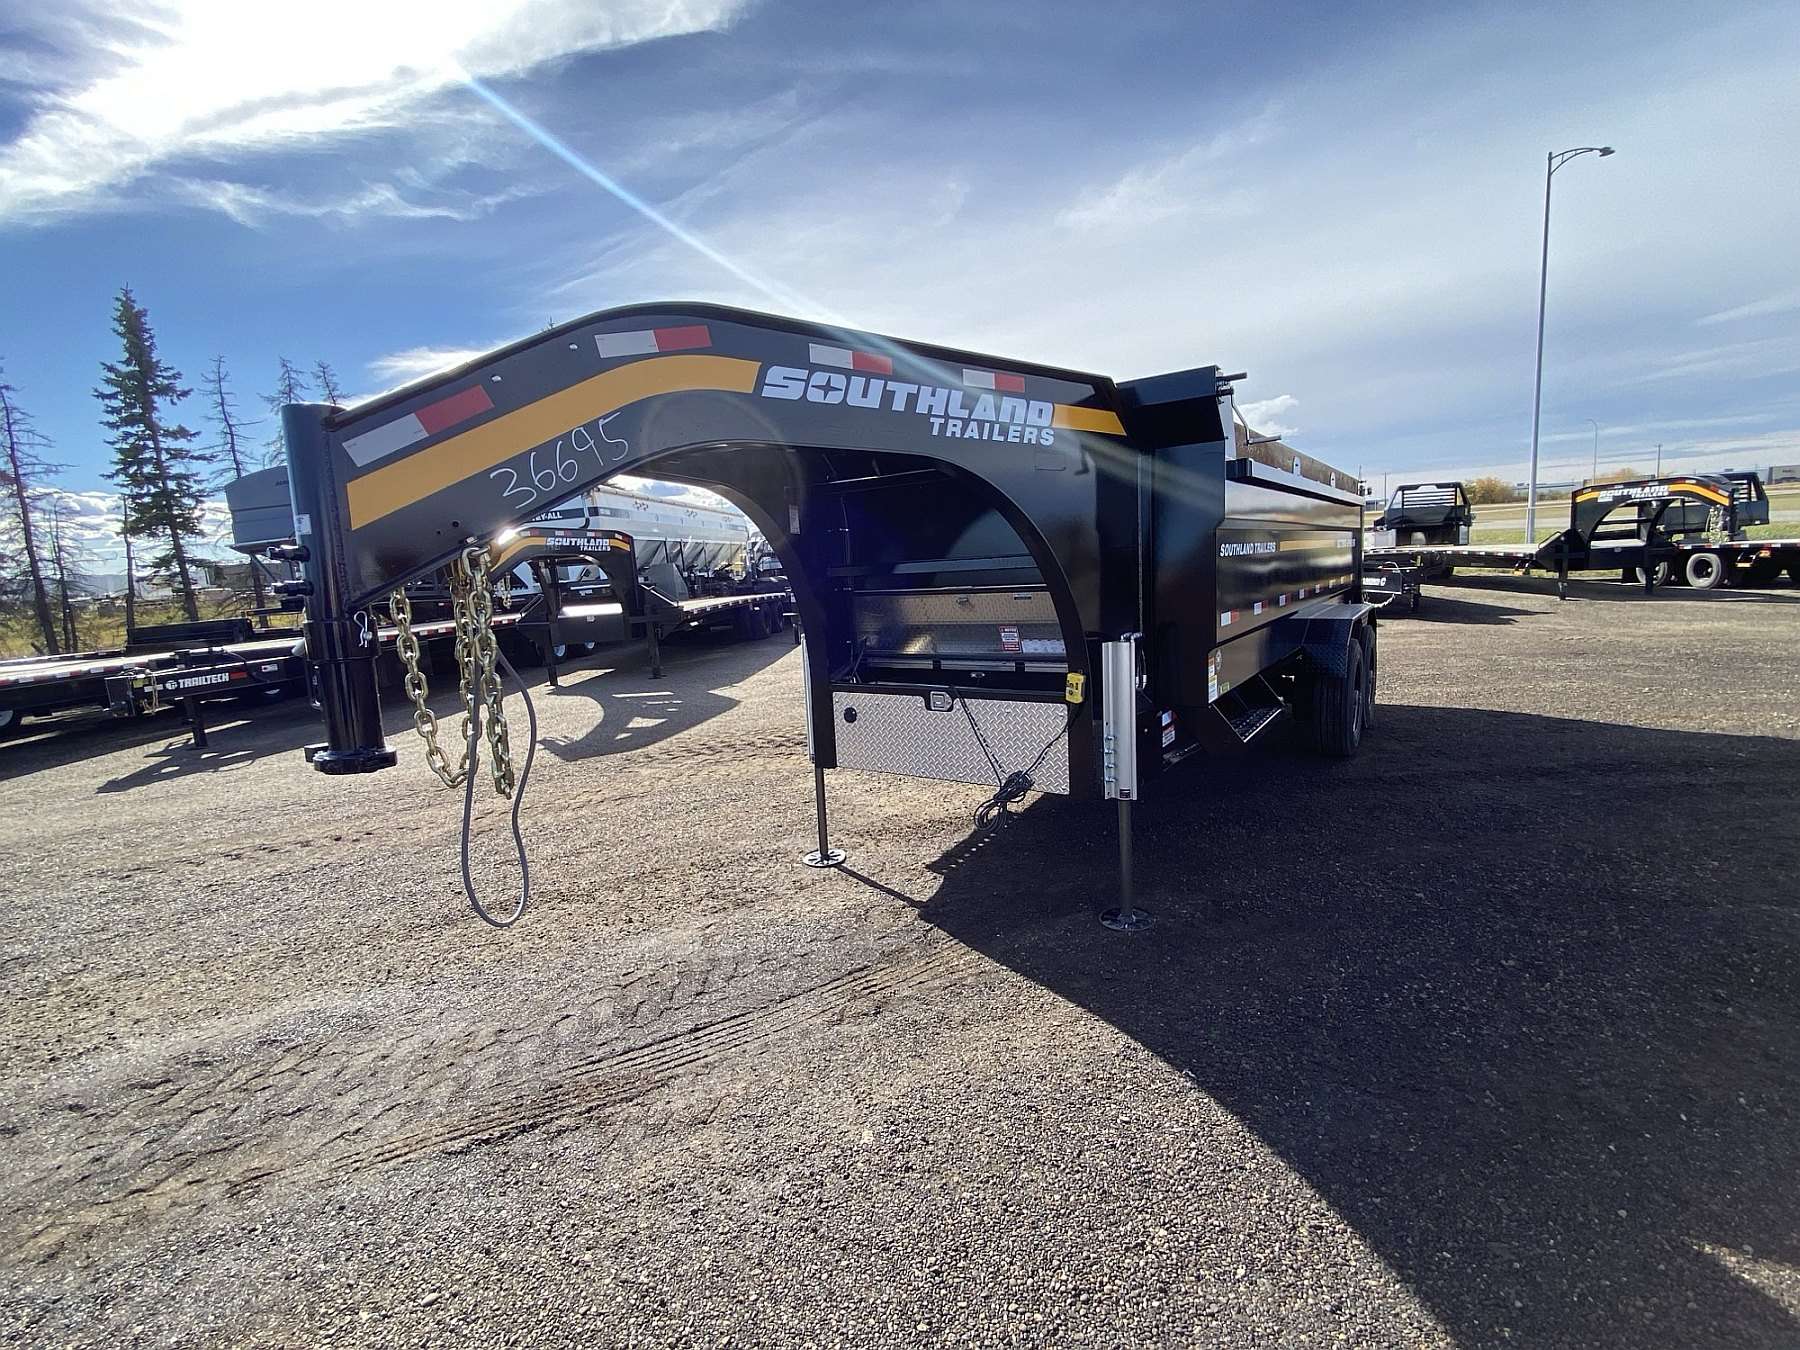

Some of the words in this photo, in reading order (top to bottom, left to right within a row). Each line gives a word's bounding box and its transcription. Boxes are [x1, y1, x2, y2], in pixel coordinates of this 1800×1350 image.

[761, 365, 1054, 427] SOUTHLAND
[929, 417, 1055, 446] TRAILERS
[489, 411, 629, 509] 36695
[546, 537, 610, 546] SOUTHLAND
[1219, 542, 1254, 557] SOUTHLAND
[1254, 541, 1277, 554] TRAILERS
[178, 672, 230, 689] TRAILTECH
